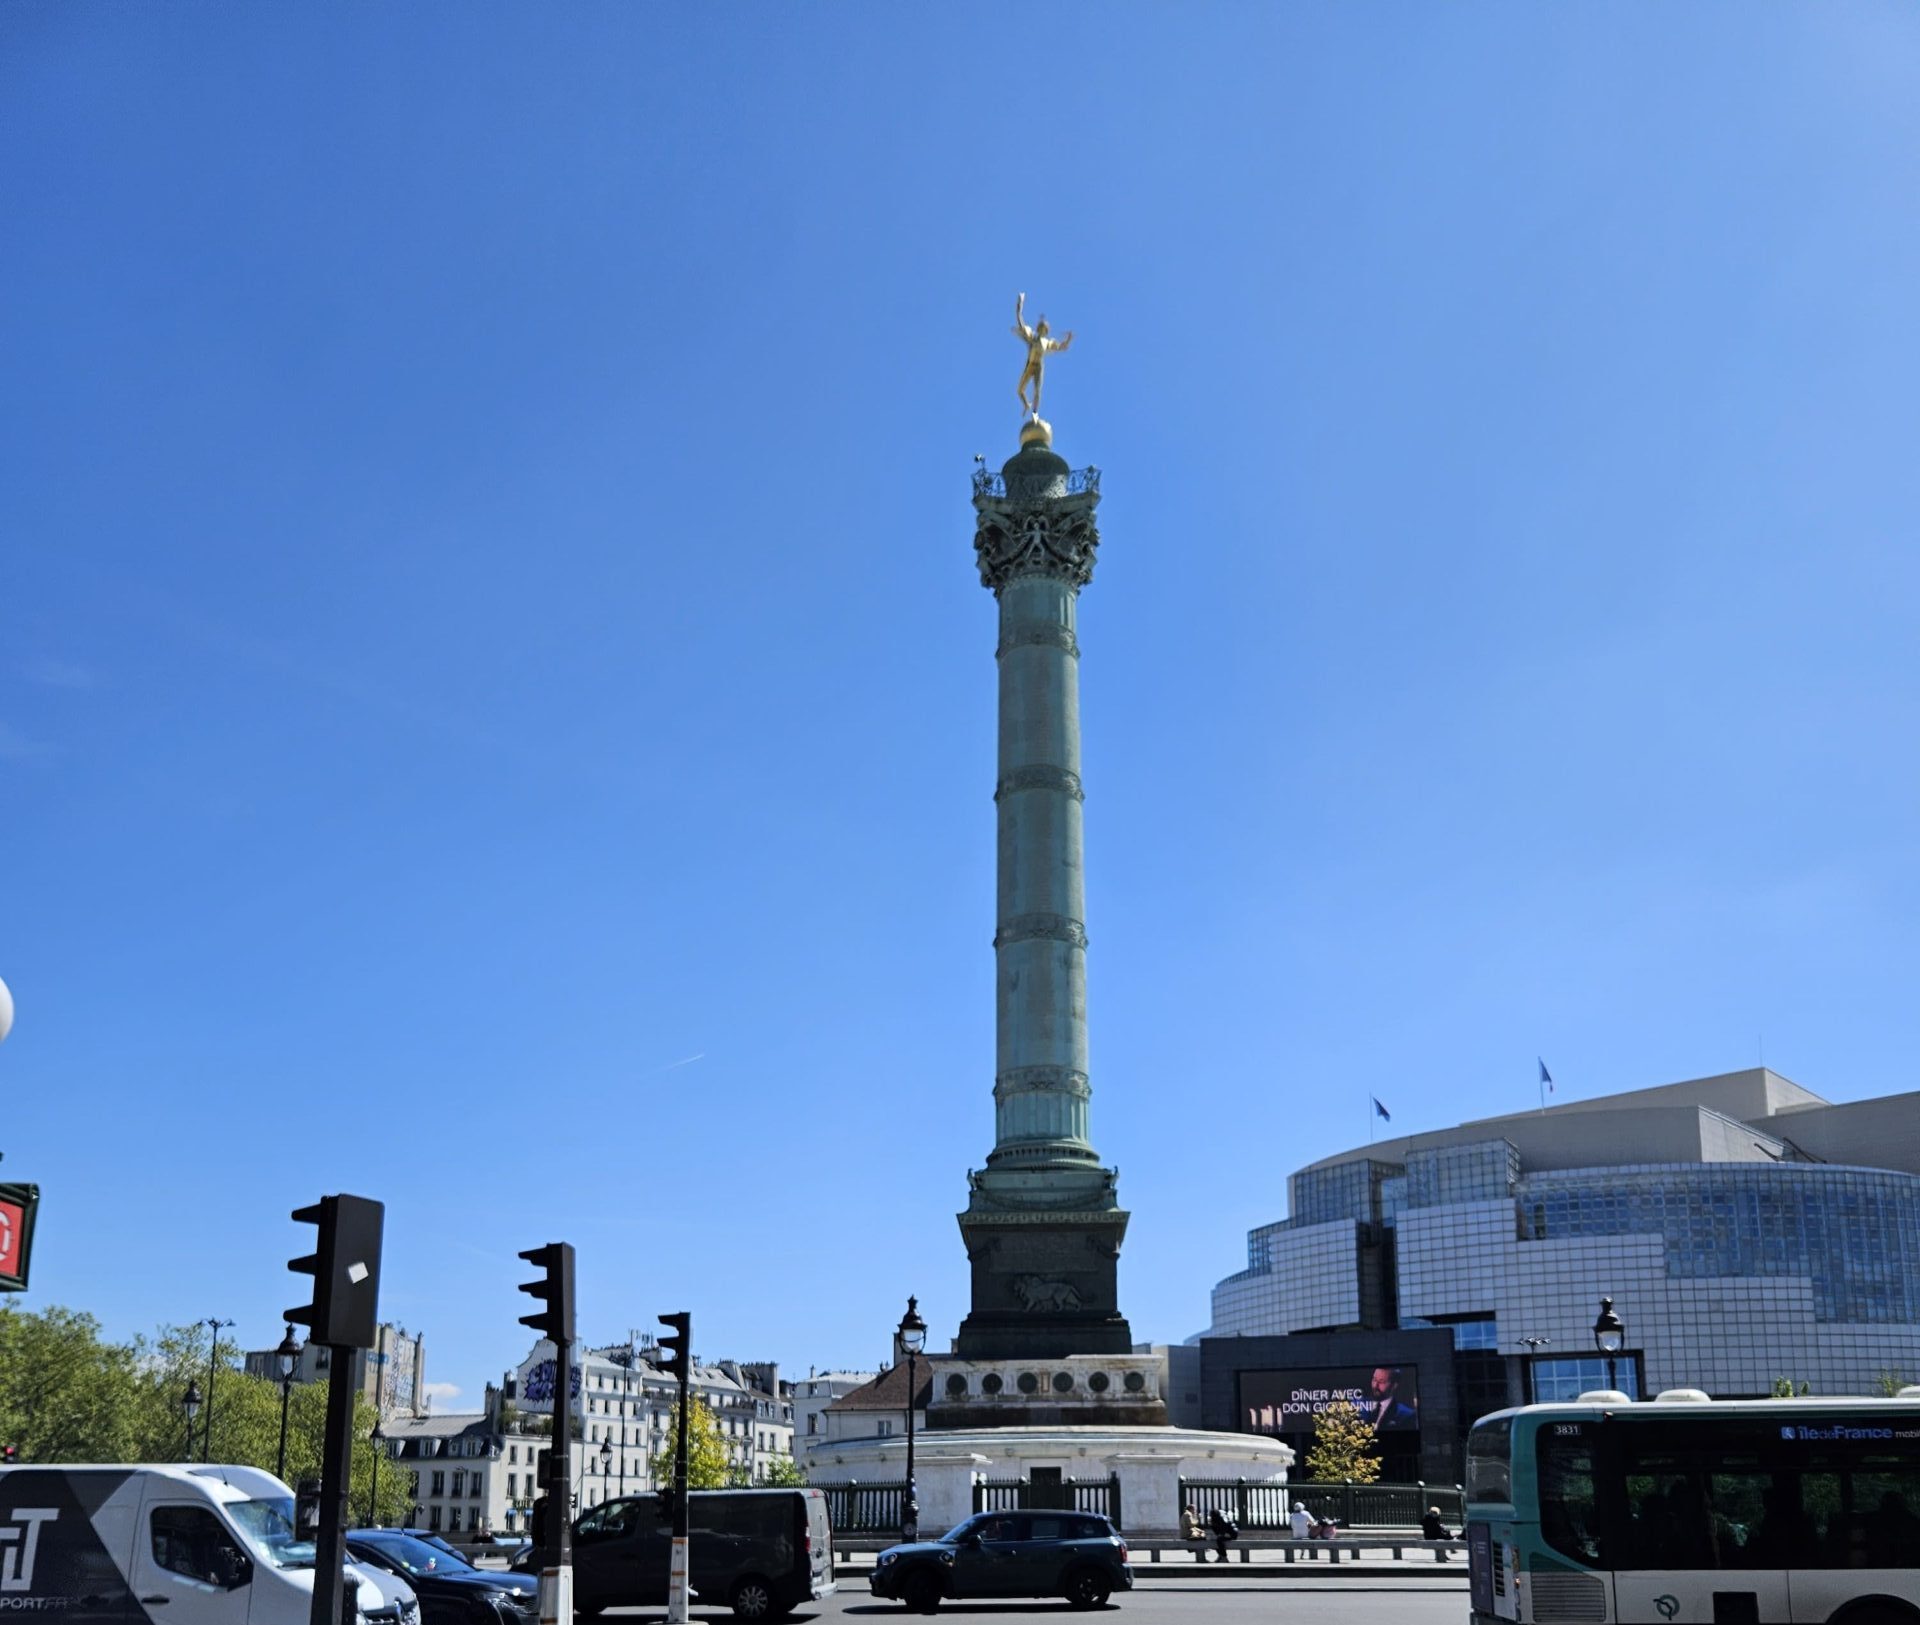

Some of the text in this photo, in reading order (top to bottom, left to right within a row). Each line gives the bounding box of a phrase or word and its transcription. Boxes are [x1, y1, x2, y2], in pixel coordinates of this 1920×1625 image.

[1291, 1388, 1362, 1401] DÎNER AVEC
[1282, 1402, 1309, 1413] DON
[1555, 1425, 1578, 1435] 3831
